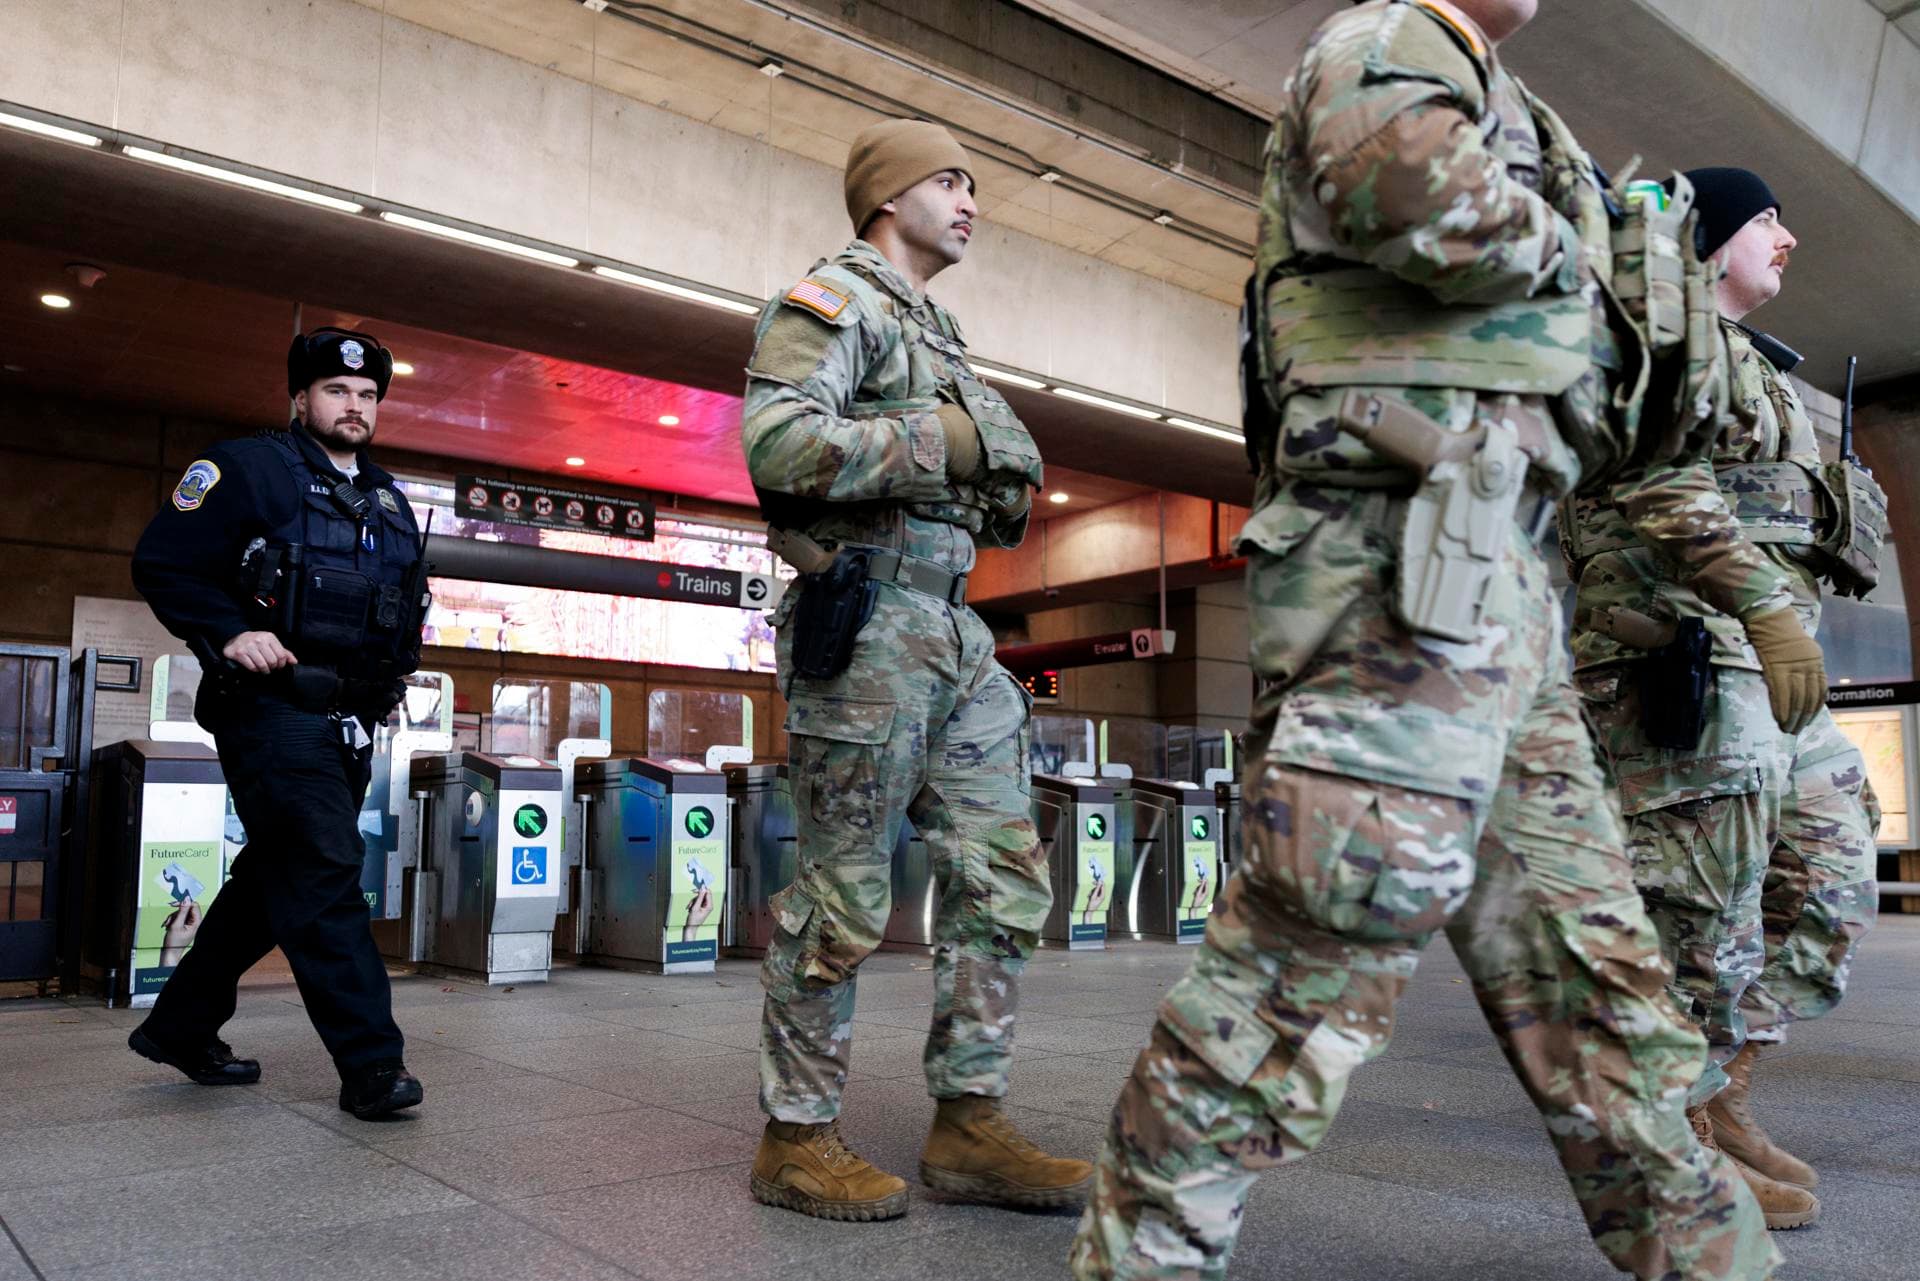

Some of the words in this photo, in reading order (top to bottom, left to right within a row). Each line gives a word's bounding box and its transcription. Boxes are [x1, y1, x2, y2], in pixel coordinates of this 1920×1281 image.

[475, 477, 487, 485] The
[487, 479, 515, 490] following
[527, 485, 547, 495] strictly
[547, 488, 577, 499] prohibited
[620, 498, 640, 507] system
[676, 572, 732, 596] Trains
[1826, 688, 1895, 702] formation
[150, 848, 210, 859] FutureCard
[678, 846, 717, 855] FutureCard
[143, 976, 169, 984] futureca
